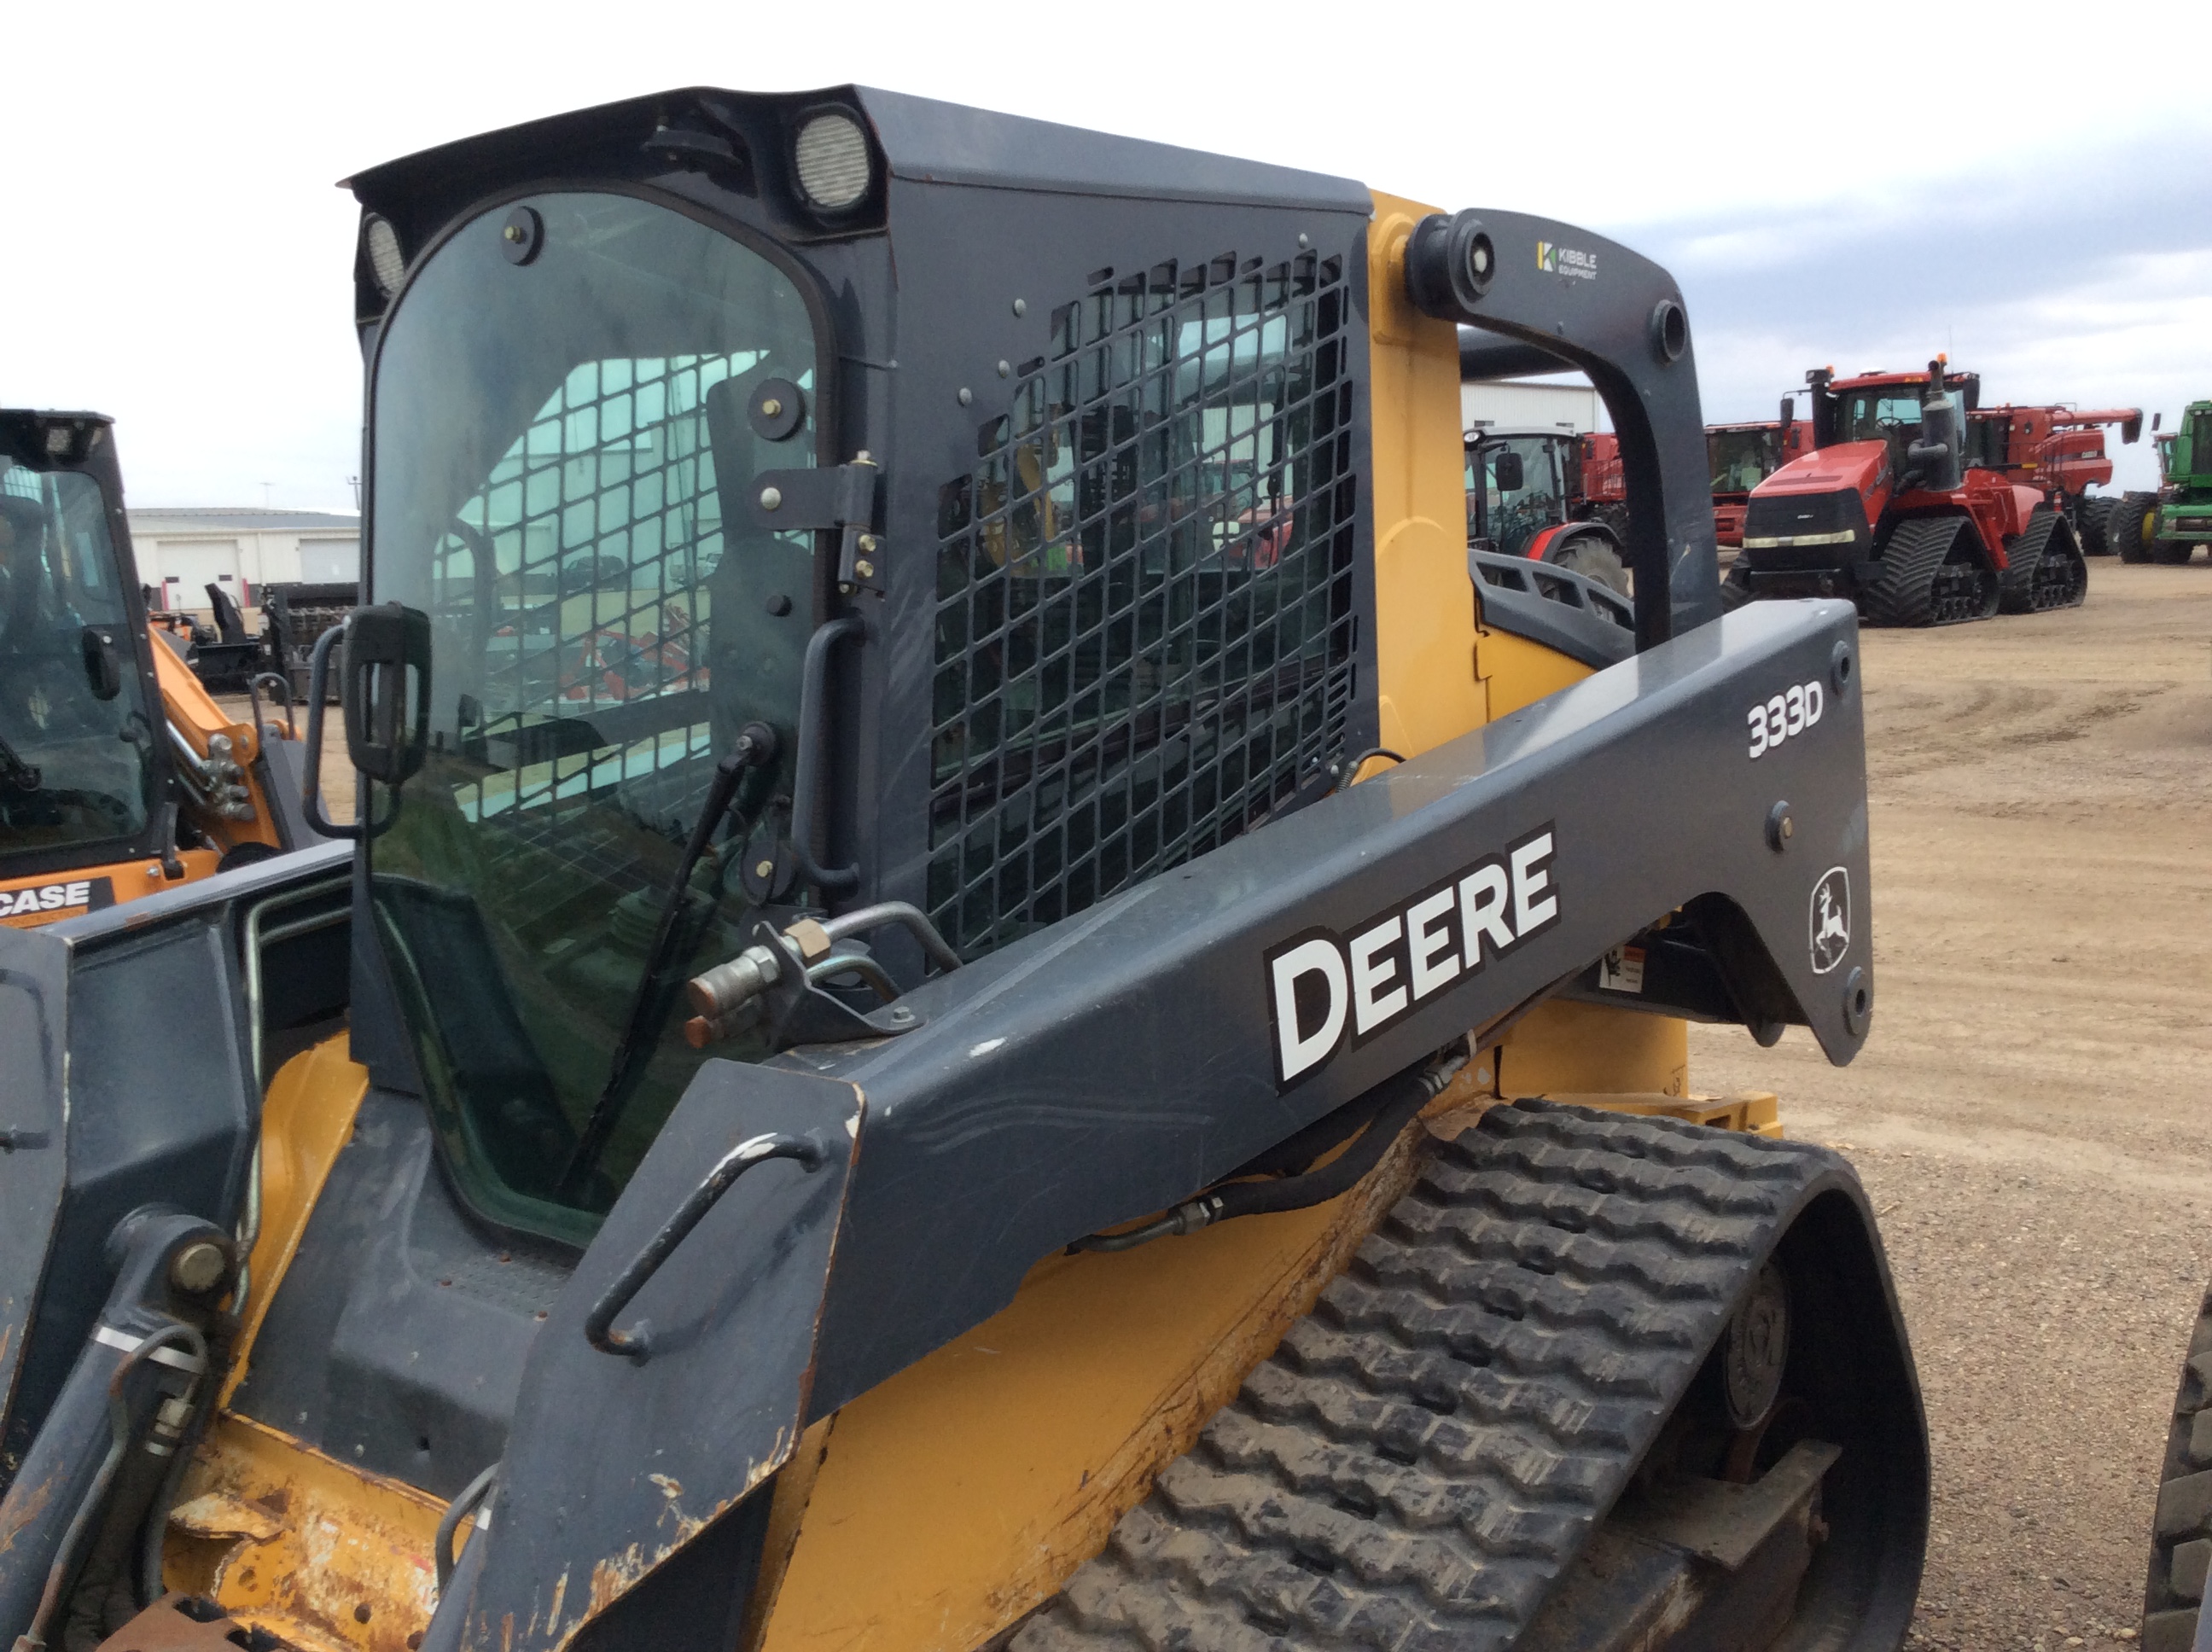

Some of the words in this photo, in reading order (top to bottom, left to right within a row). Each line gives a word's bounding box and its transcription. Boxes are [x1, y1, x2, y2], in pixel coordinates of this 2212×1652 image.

[1558, 247, 1597, 269] KIBBLE
[1558, 265, 1597, 280] EQUIPMENT
[1747, 680, 1824, 759] 333D
[1272, 832, 1557, 1082] DEERE
